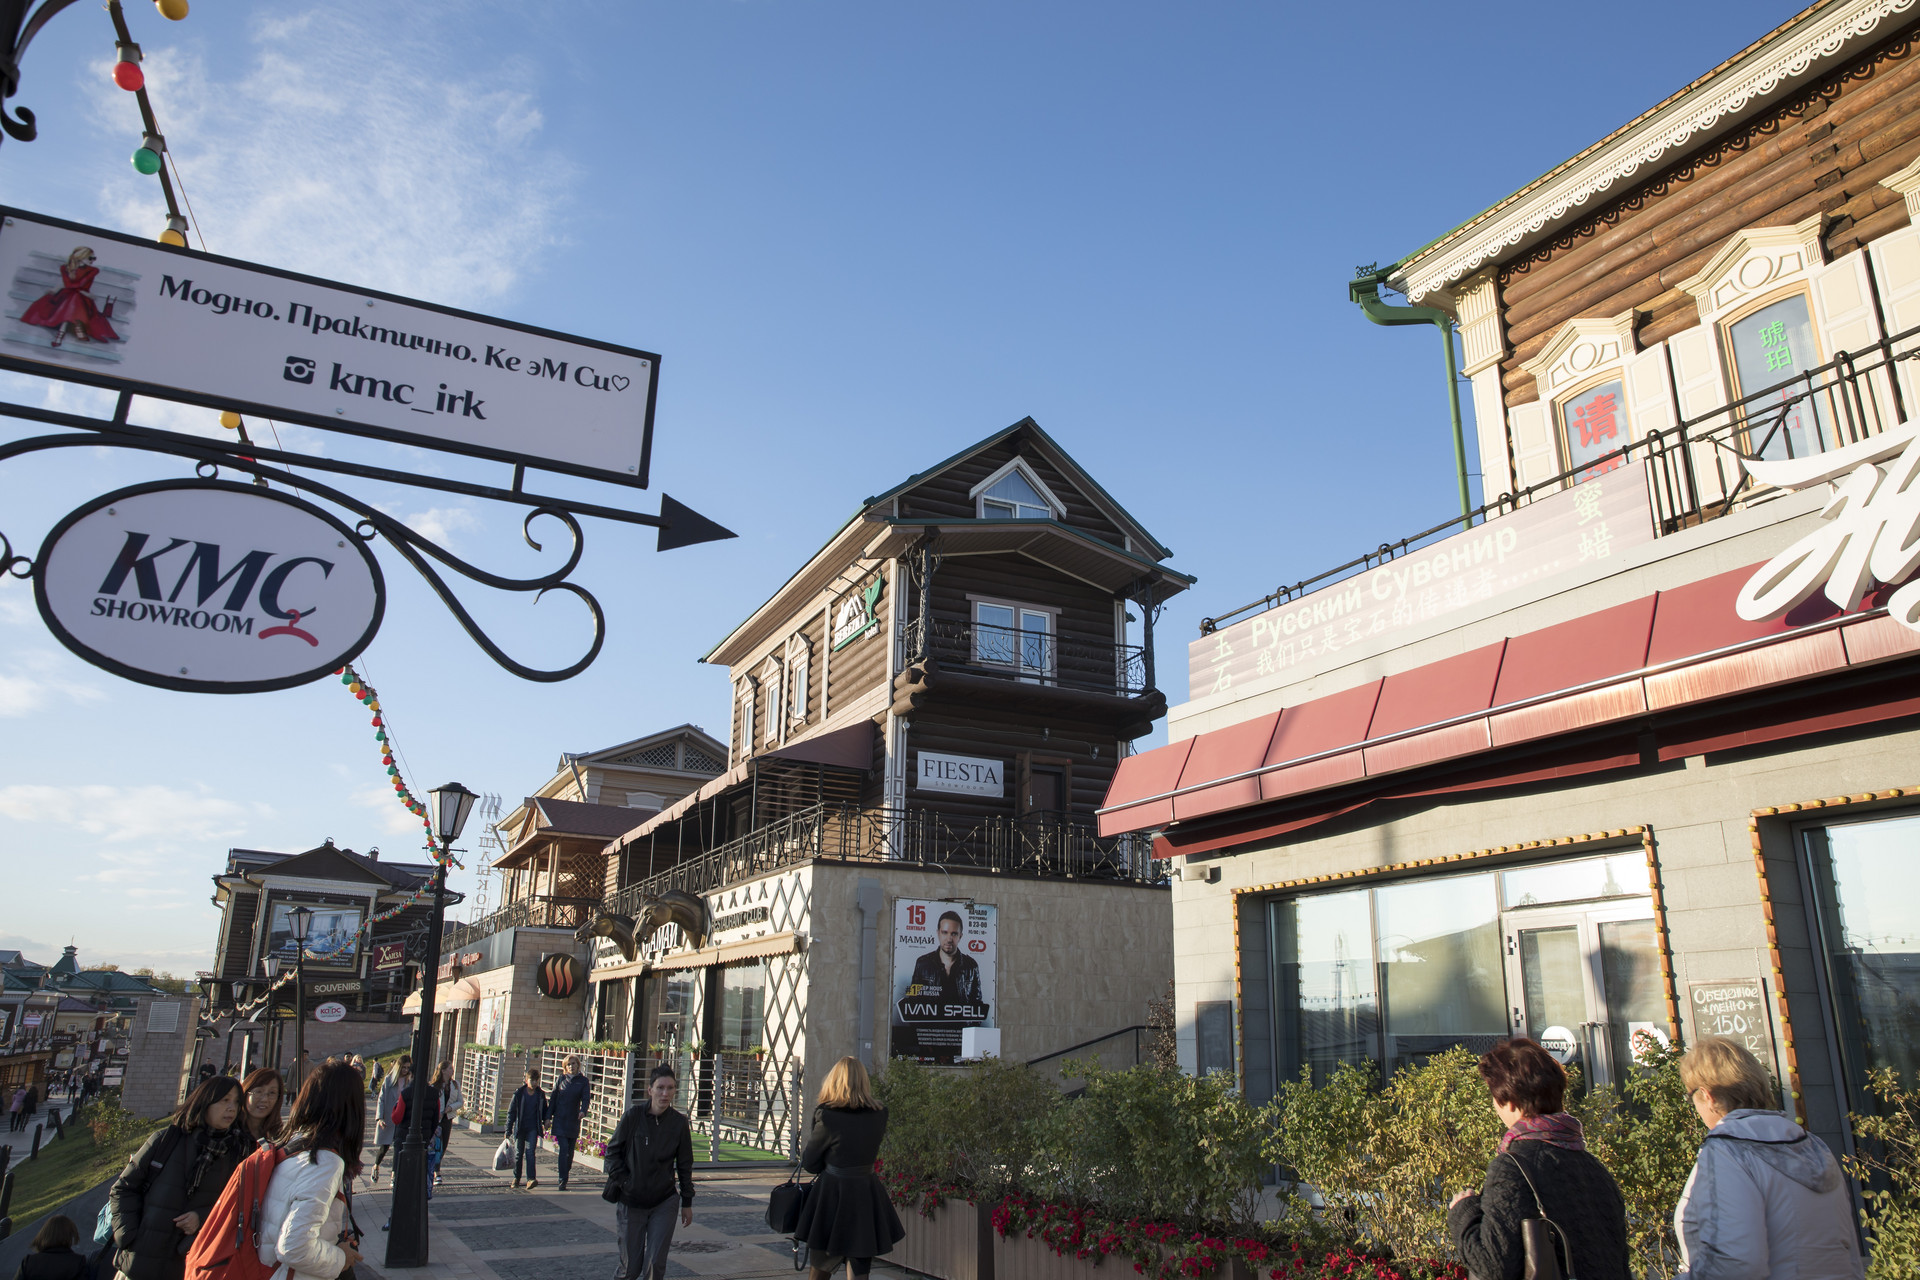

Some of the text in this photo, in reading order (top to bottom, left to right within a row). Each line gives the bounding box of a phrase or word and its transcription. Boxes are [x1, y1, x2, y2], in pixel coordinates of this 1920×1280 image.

[158, 273, 280, 322] Модно.
[287, 301, 478, 364] Практично.
[484, 344, 522, 373] Ке
[1758, 320, 1793, 372] 琥珀
[329, 362, 488, 420] kmc_irk
[1572, 481, 1615, 563] 蜜蜡
[1251, 526, 1518, 649] Русский Сувенир
[90, 596, 255, 637] SHOWROOM
[1210, 630, 1234, 695] 玉石
[923, 758, 998, 785] FIESTA
[935, 781, 985, 791] Showroom
[906, 905, 926, 926] 15
[899, 934, 935, 946] МАМАЙ
[314, 982, 361, 993] SOUVENIRS
[904, 1003, 985, 1018] IVAN SPELL
[1713, 1014, 1748, 1036] 150
